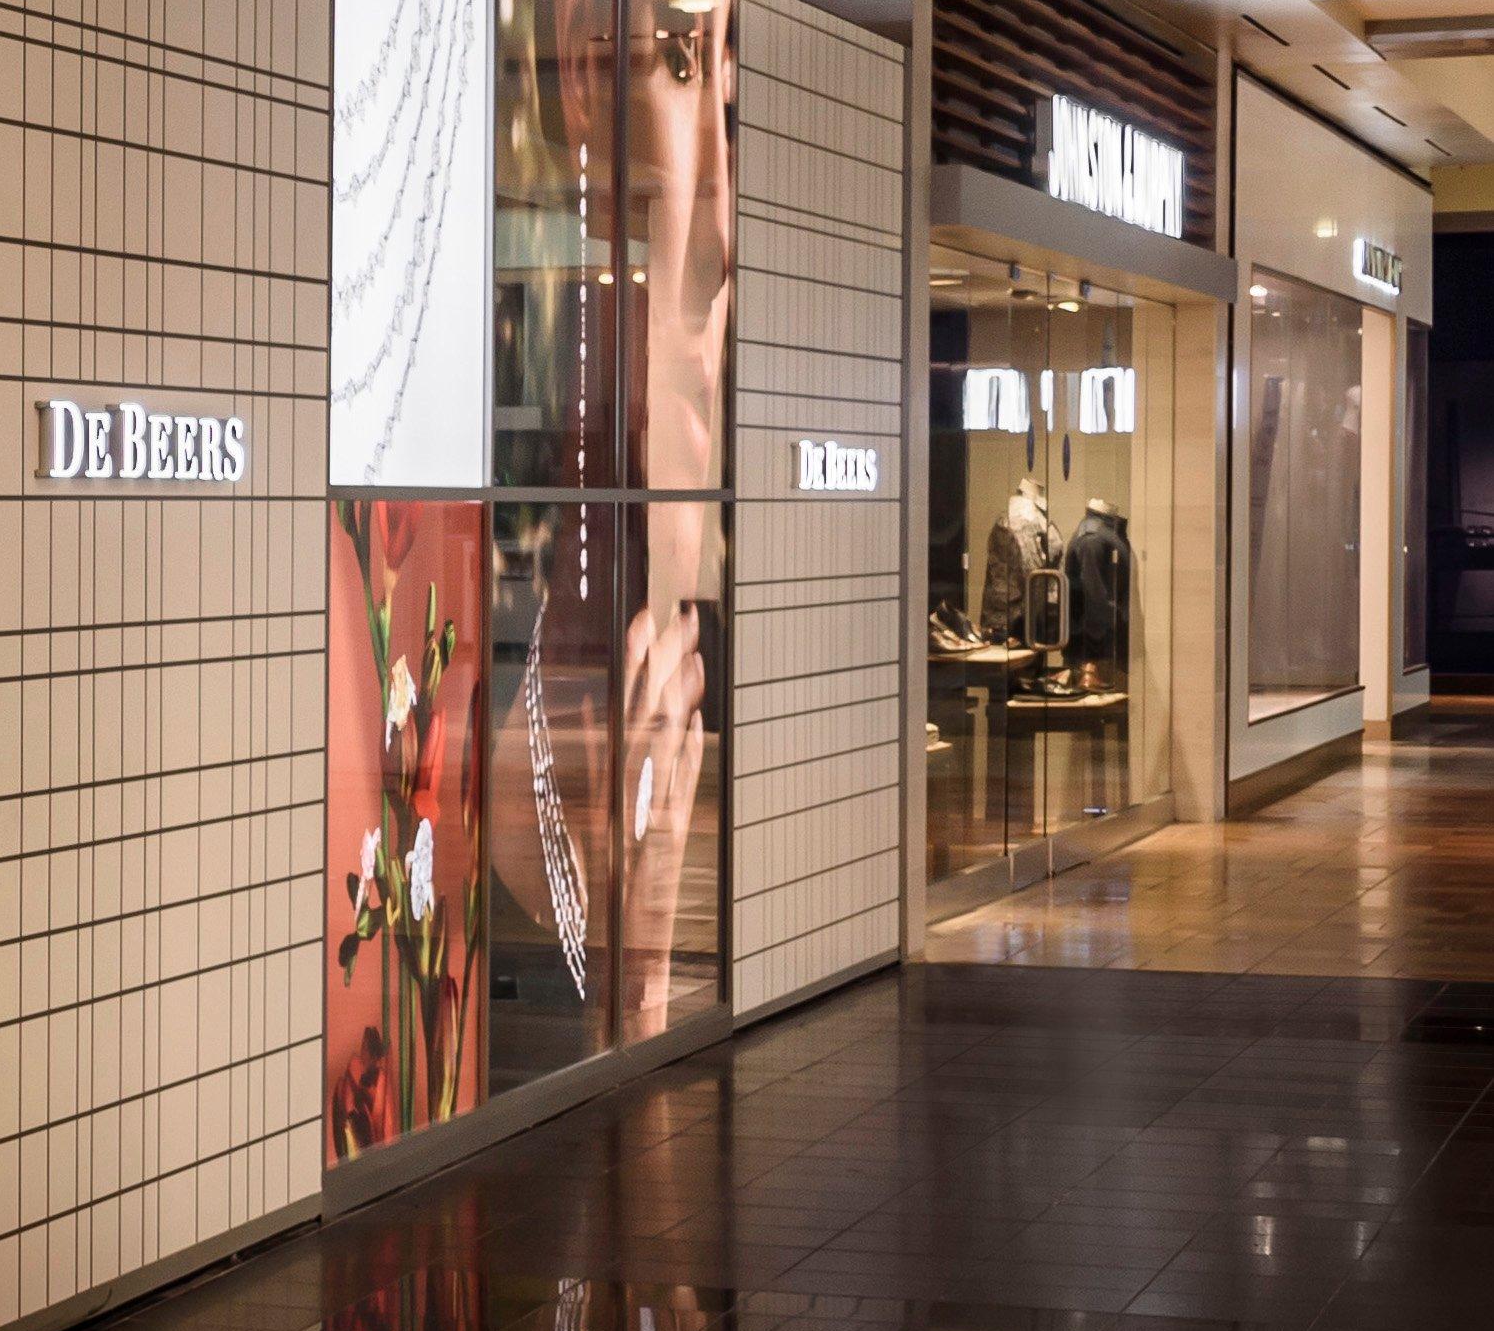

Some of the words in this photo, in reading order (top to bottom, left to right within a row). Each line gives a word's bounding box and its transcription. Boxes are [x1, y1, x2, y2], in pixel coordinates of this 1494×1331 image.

[49, 400, 113, 478] DE
[119, 402, 245, 482] BEERS
[798, 439, 825, 490] DE
[824, 440, 878, 492] BEERS
